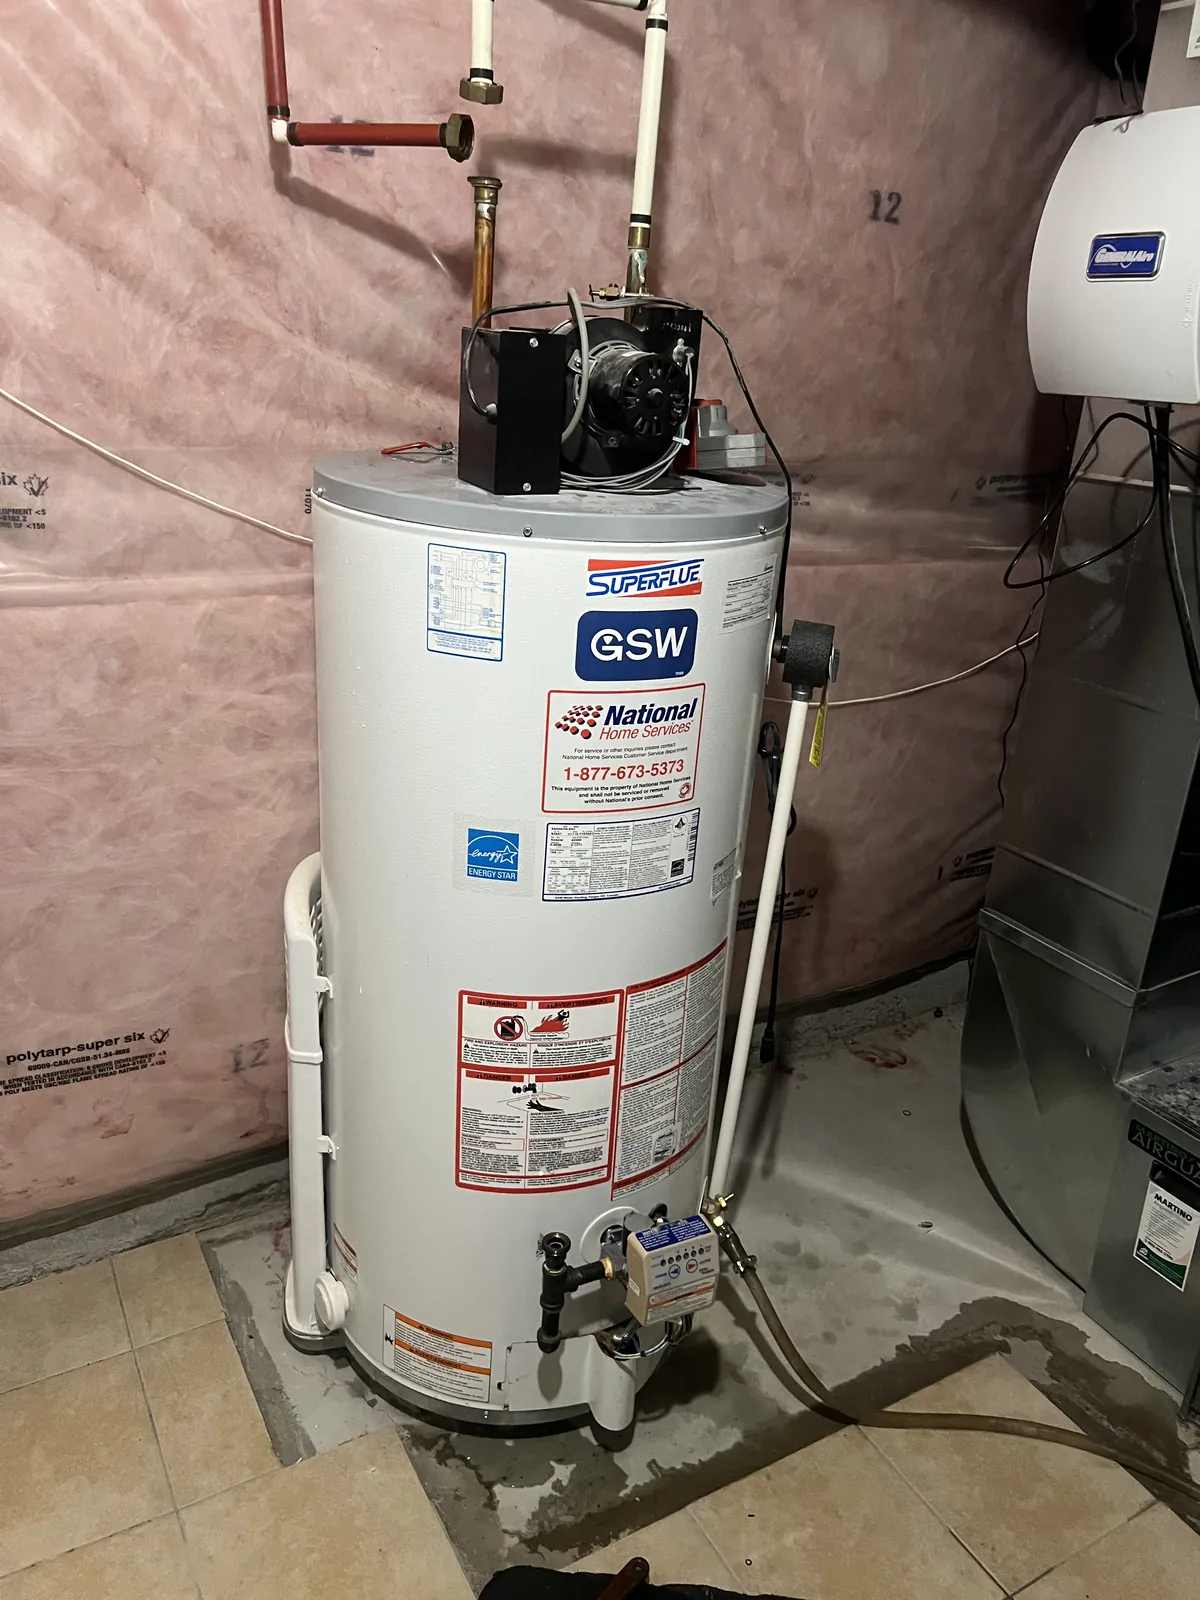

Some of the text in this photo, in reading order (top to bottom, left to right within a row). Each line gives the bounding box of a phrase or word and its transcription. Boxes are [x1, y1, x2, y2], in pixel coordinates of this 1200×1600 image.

[869, 189, 902, 225] 12
[0, 472, 18, 486] ix
[586, 564, 701, 596] SUPERFLUE
[590, 626, 688, 662] GSW
[604, 698, 698, 726] National
[599, 721, 692, 740] Home Services
[564, 759, 684, 781] 1-877-673-5373
[471, 849, 502, 863] energy
[468, 867, 516, 880] ENERGY STAR
[486, 1000, 518, 1008] WARNING
[554, 997, 608, 1008] AVERTISSEMENT
[6, 1032, 146, 1065] polytarp-super six
[483, 1073, 511, 1081] DANGER
[563, 1071, 590, 1080] DANGER
[1154, 1193, 1193, 1222] MARTINO
